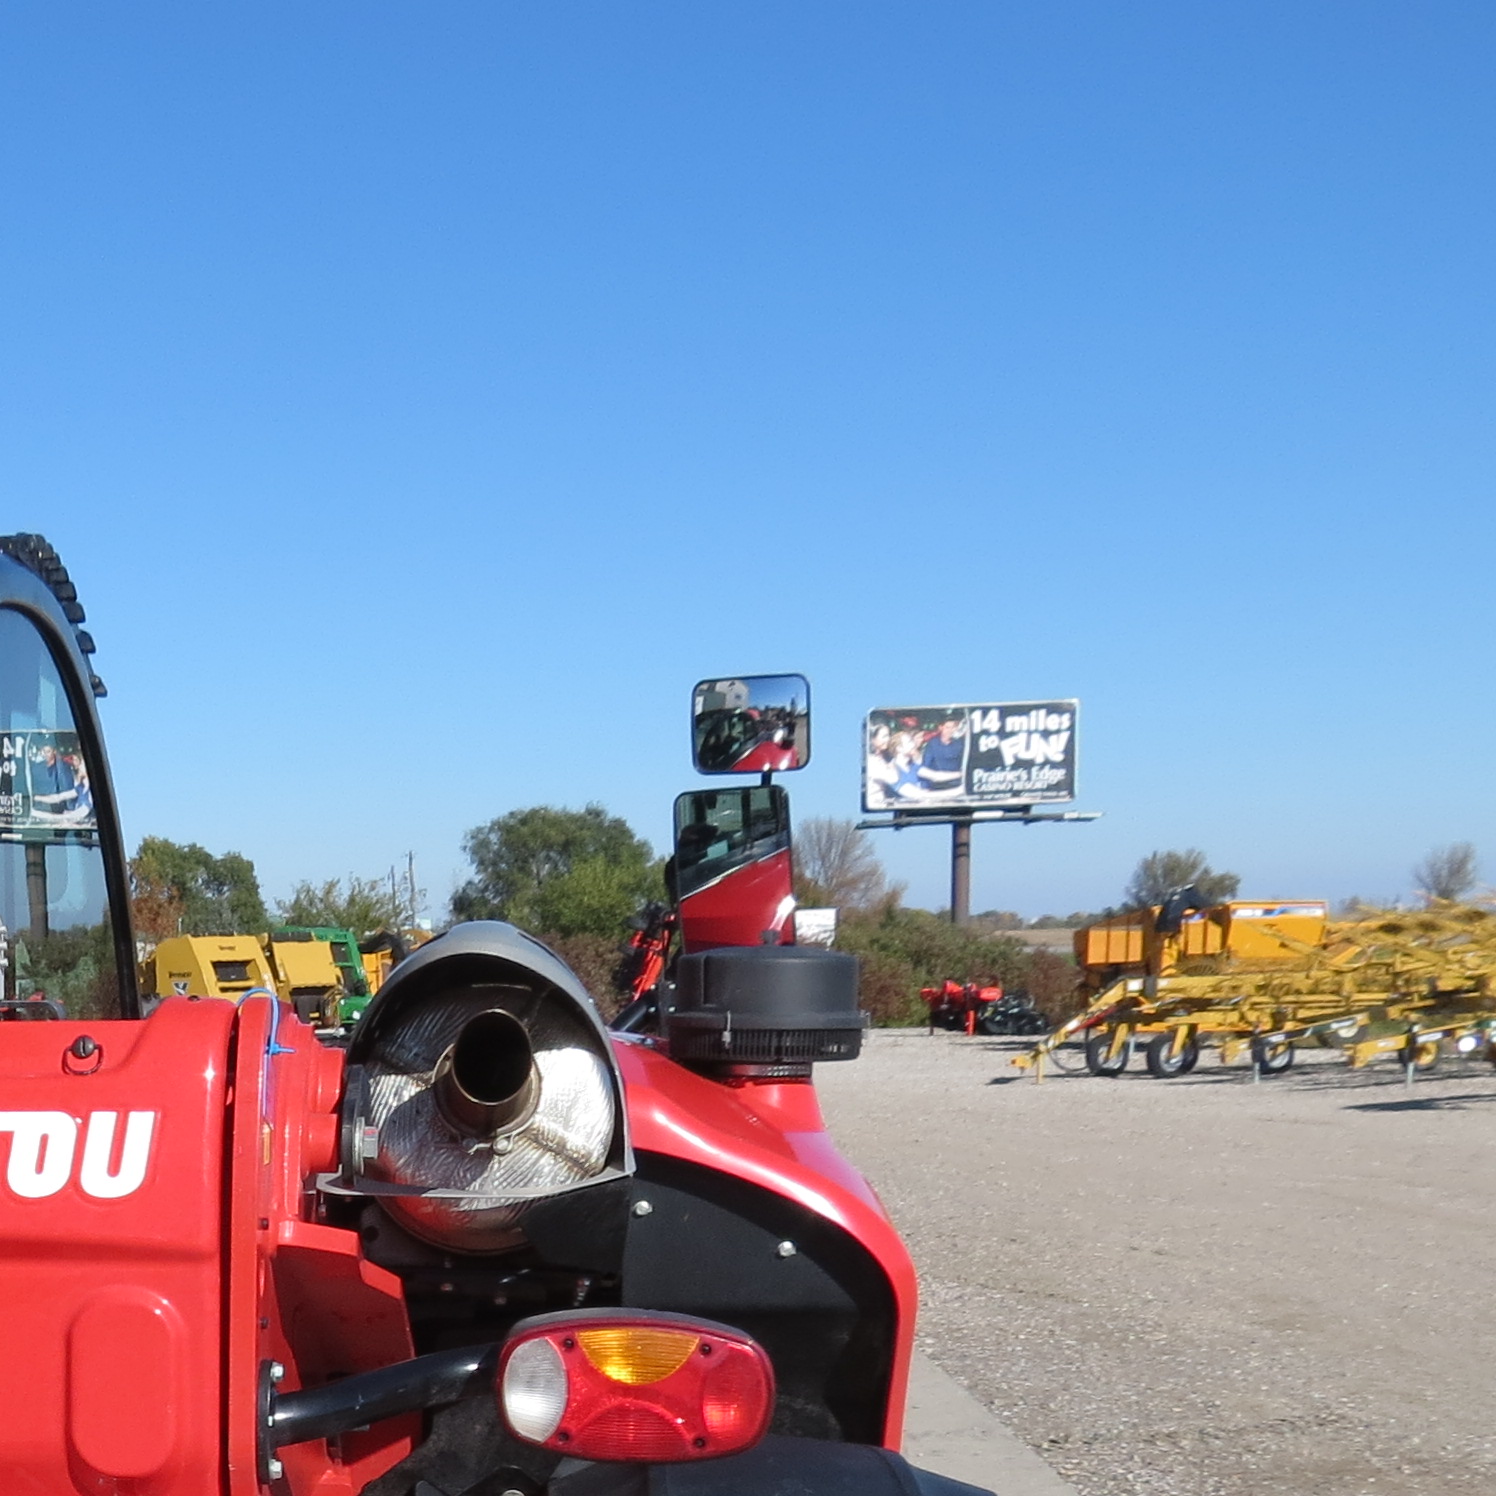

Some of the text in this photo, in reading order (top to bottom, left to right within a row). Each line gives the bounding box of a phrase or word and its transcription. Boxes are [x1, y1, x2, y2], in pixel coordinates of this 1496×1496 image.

[971, 708, 1071, 733] 14 miles
[978, 731, 1070, 766] to FUN!
[973, 764, 1067, 785] Prairie's Edge
